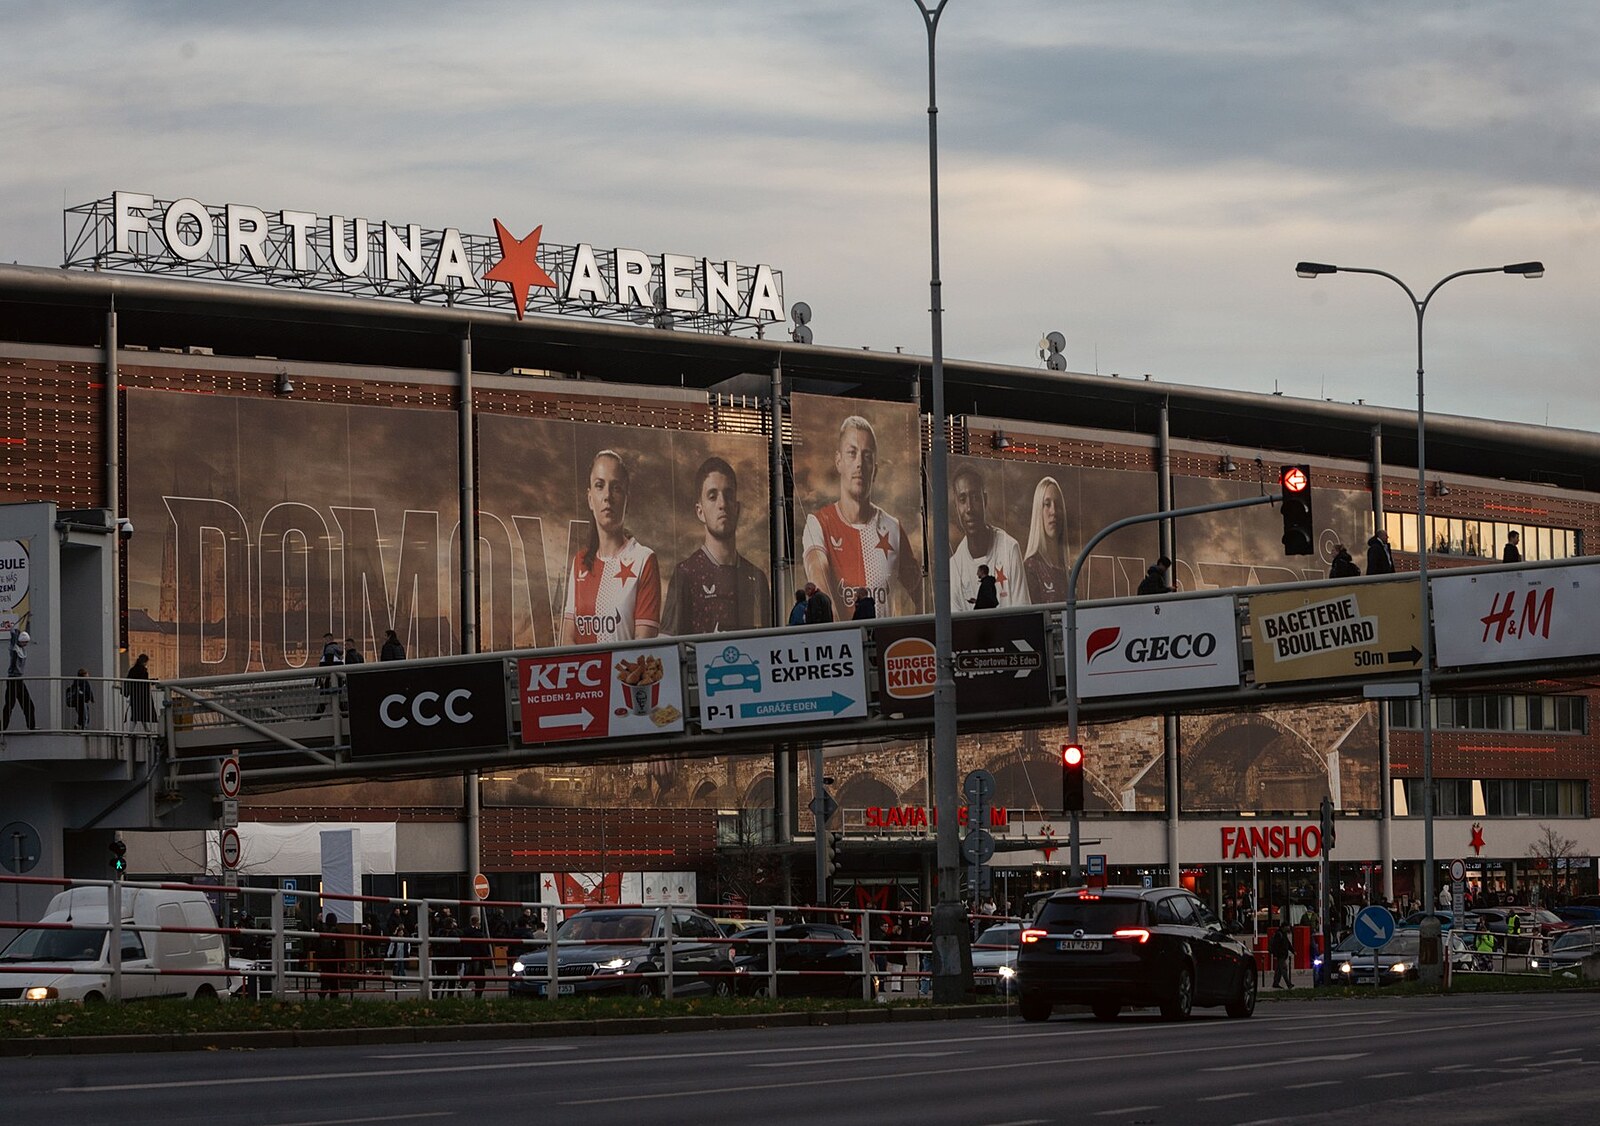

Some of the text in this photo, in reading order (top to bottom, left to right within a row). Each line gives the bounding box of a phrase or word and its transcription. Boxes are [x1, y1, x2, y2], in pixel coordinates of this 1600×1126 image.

[113, 190, 785, 322] FORTUNA ARENA
[1264, 598, 1355, 639] BAGETERIE
[1480, 587, 1555, 643] H&M
[1125, 632, 1217, 663] GECO
[1276, 619, 1375, 658] BOULEVARD
[770, 643, 853, 665] KLIMA
[887, 655, 936, 670] BURGER
[1020, 655, 1037, 666] Eden
[1354, 651, 1385, 668] 50m
[526, 659, 602, 692] KFC
[772, 661, 855, 684] EXPRESS
[888, 667, 936, 687] KING
[527, 690, 604, 704] NC EDEN 2. PATRO
[756, 700, 818, 714] GARÁŽE EDEN
[379, 688, 474, 729] CCC
[708, 704, 734, 721] P-1
[866, 805, 928, 827] SLAVIA
[1221, 825, 1323, 859] FANSHO
